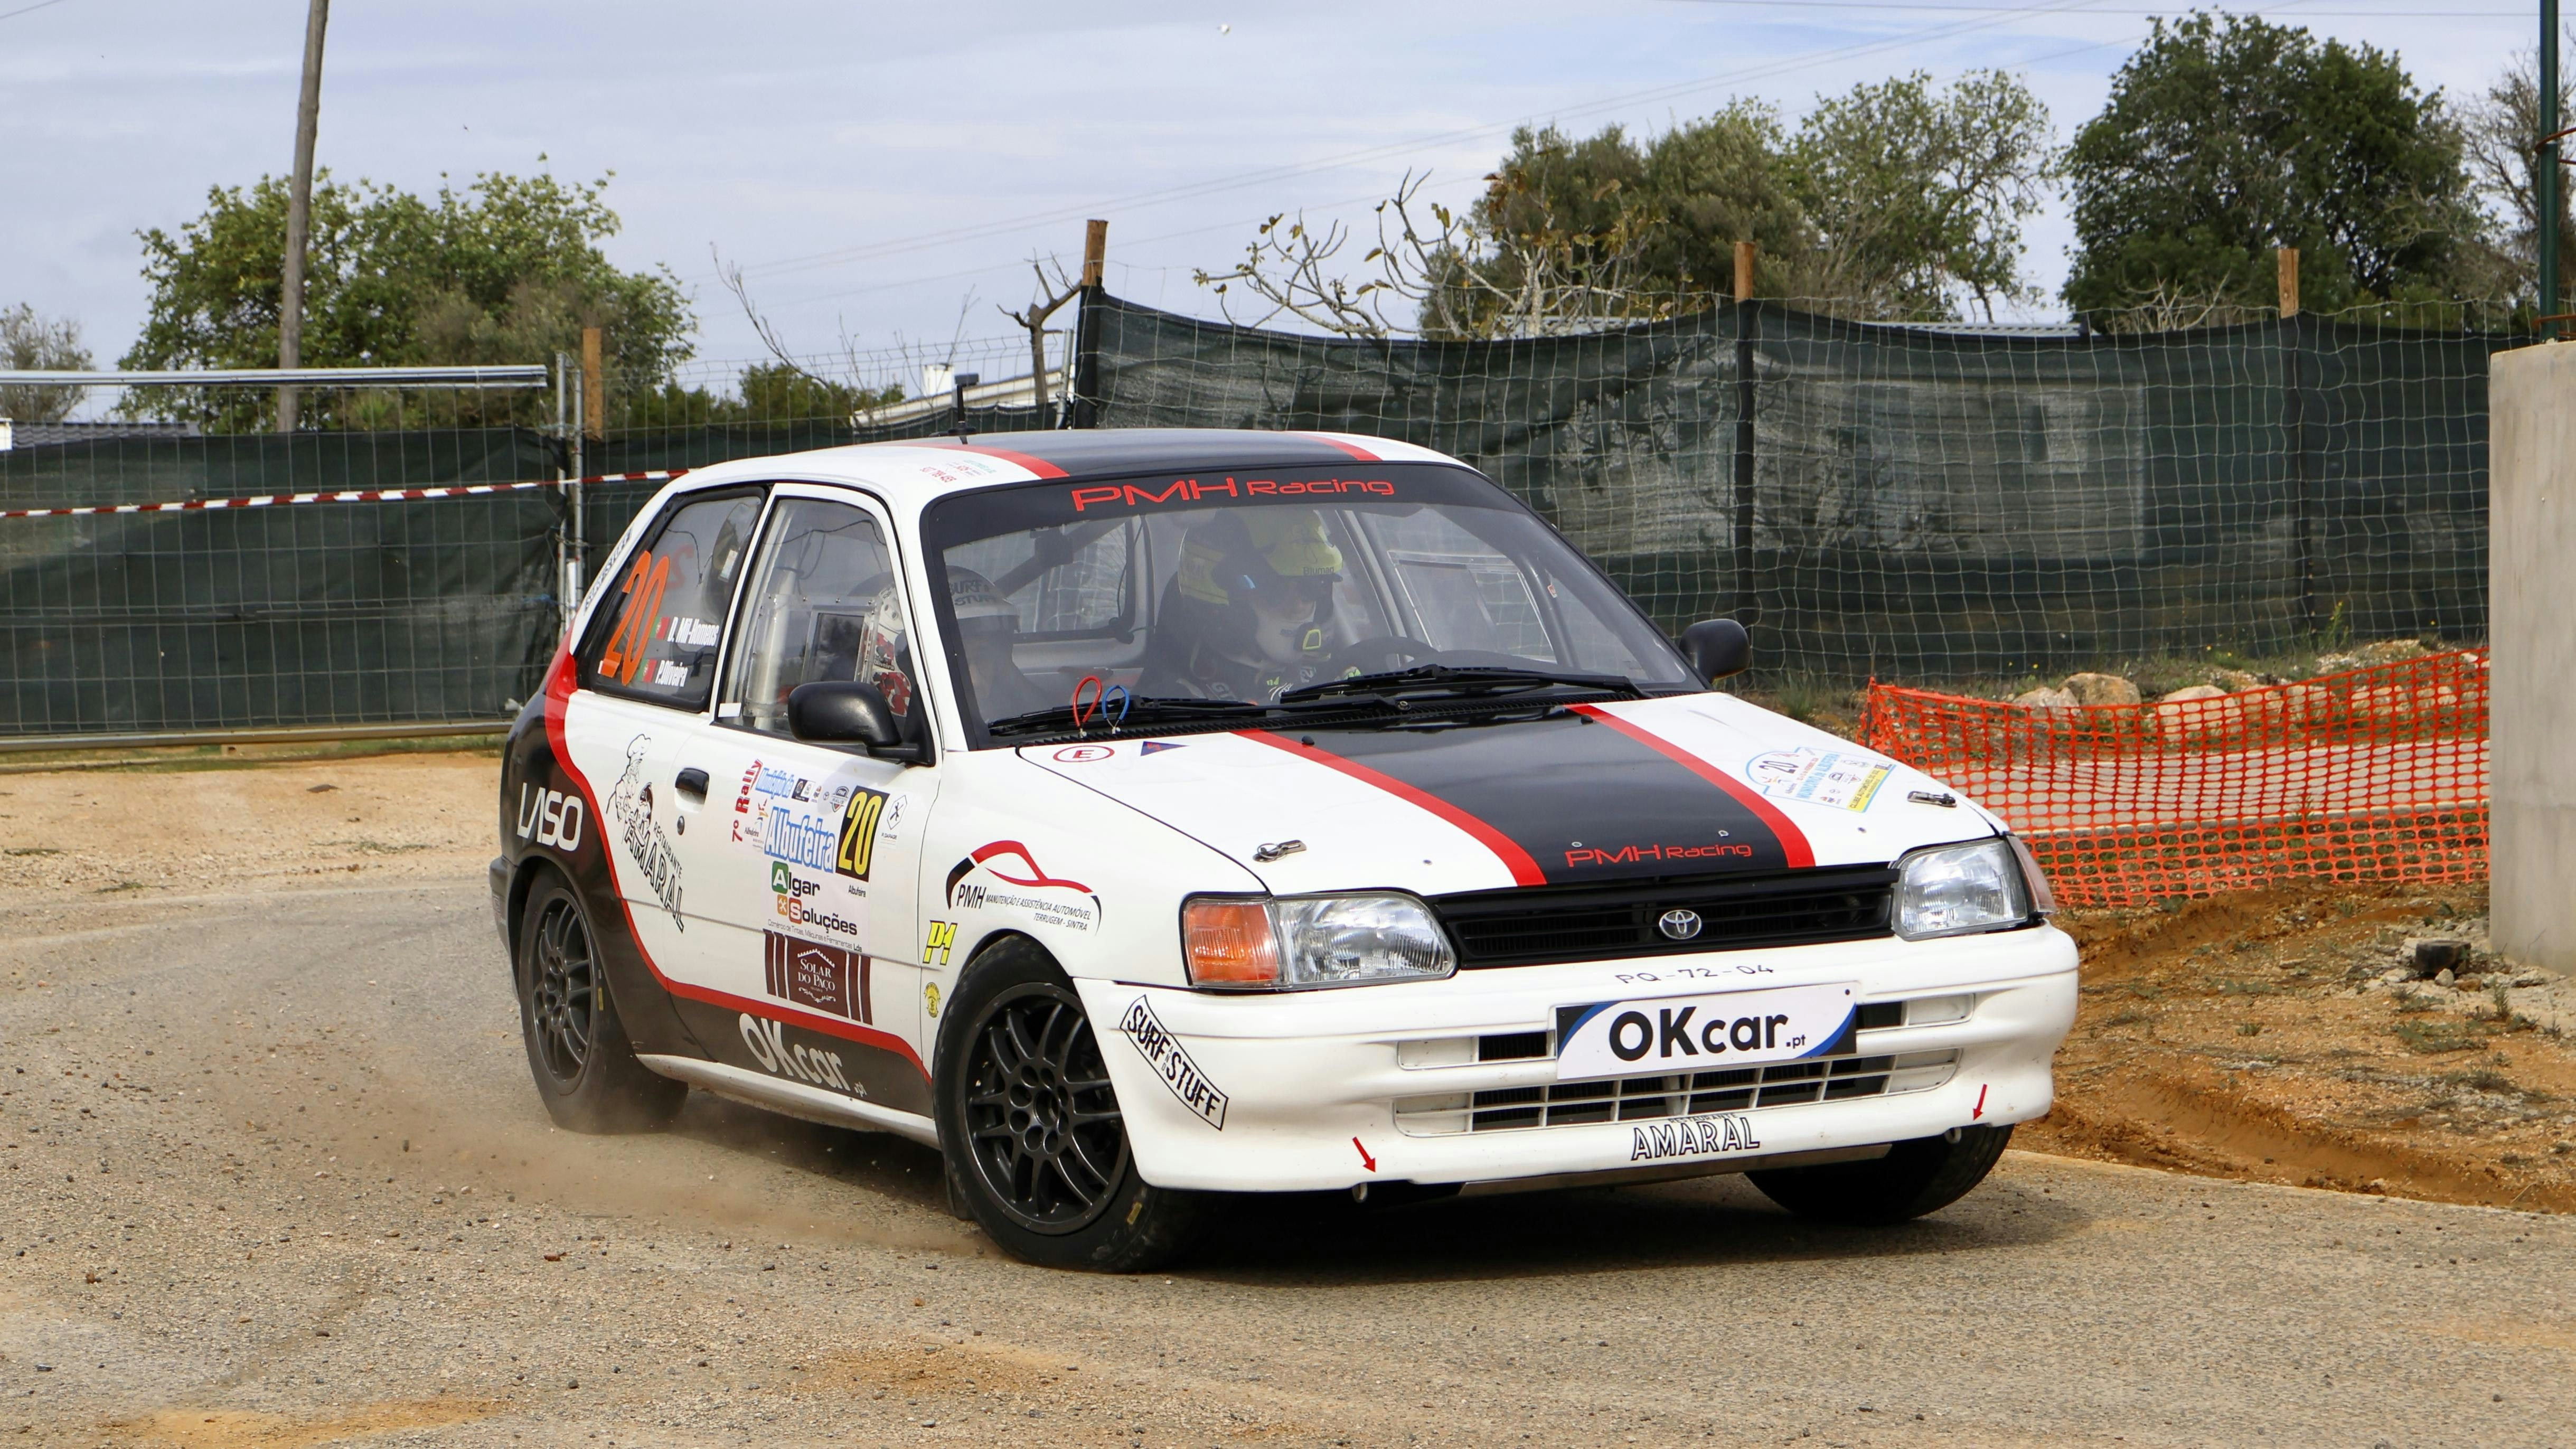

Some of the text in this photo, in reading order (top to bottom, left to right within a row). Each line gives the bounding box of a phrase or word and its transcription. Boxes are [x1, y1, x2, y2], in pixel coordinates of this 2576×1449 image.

[1072, 477, 1394, 511] PMH Racing
[601, 550, 669, 686] 20
[667, 617, 679, 642] D.
[1073, 749, 1095, 758] E
[1759, 760, 1799, 774] 20
[735, 759, 763, 814] Rally
[517, 783, 583, 851] LASO
[838, 791, 882, 876] 20
[653, 822, 682, 879] RESTAURANTE
[764, 806, 836, 874] Albufeira
[1565, 844, 1753, 868] PMH Racing
[624, 825, 685, 934] AMARAL
[773, 869, 820, 897] Algar
[790, 901, 858, 935] Soluções
[956, 884, 986, 909] PMH
[985, 894, 1017, 907] MANUTENÇÃO
[1020, 899, 1052, 911] ASSISTÊNCIA
[1052, 904, 1092, 920] AUTOMÓVEL
[1033, 912, 1063, 925] TERRUGEM
[1066, 920, 1088, 931] SINTRA
[853, 943, 862, 952] Lda
[798, 972, 835, 991] DO PAÇO
[800, 958, 832, 978] SOLAR
[1127, 1005, 1220, 1117] SURF AND STUFF
[1668, 1113, 1740, 1123] RESTAURANTE
[1630, 1117, 1761, 1161] AMARAL
